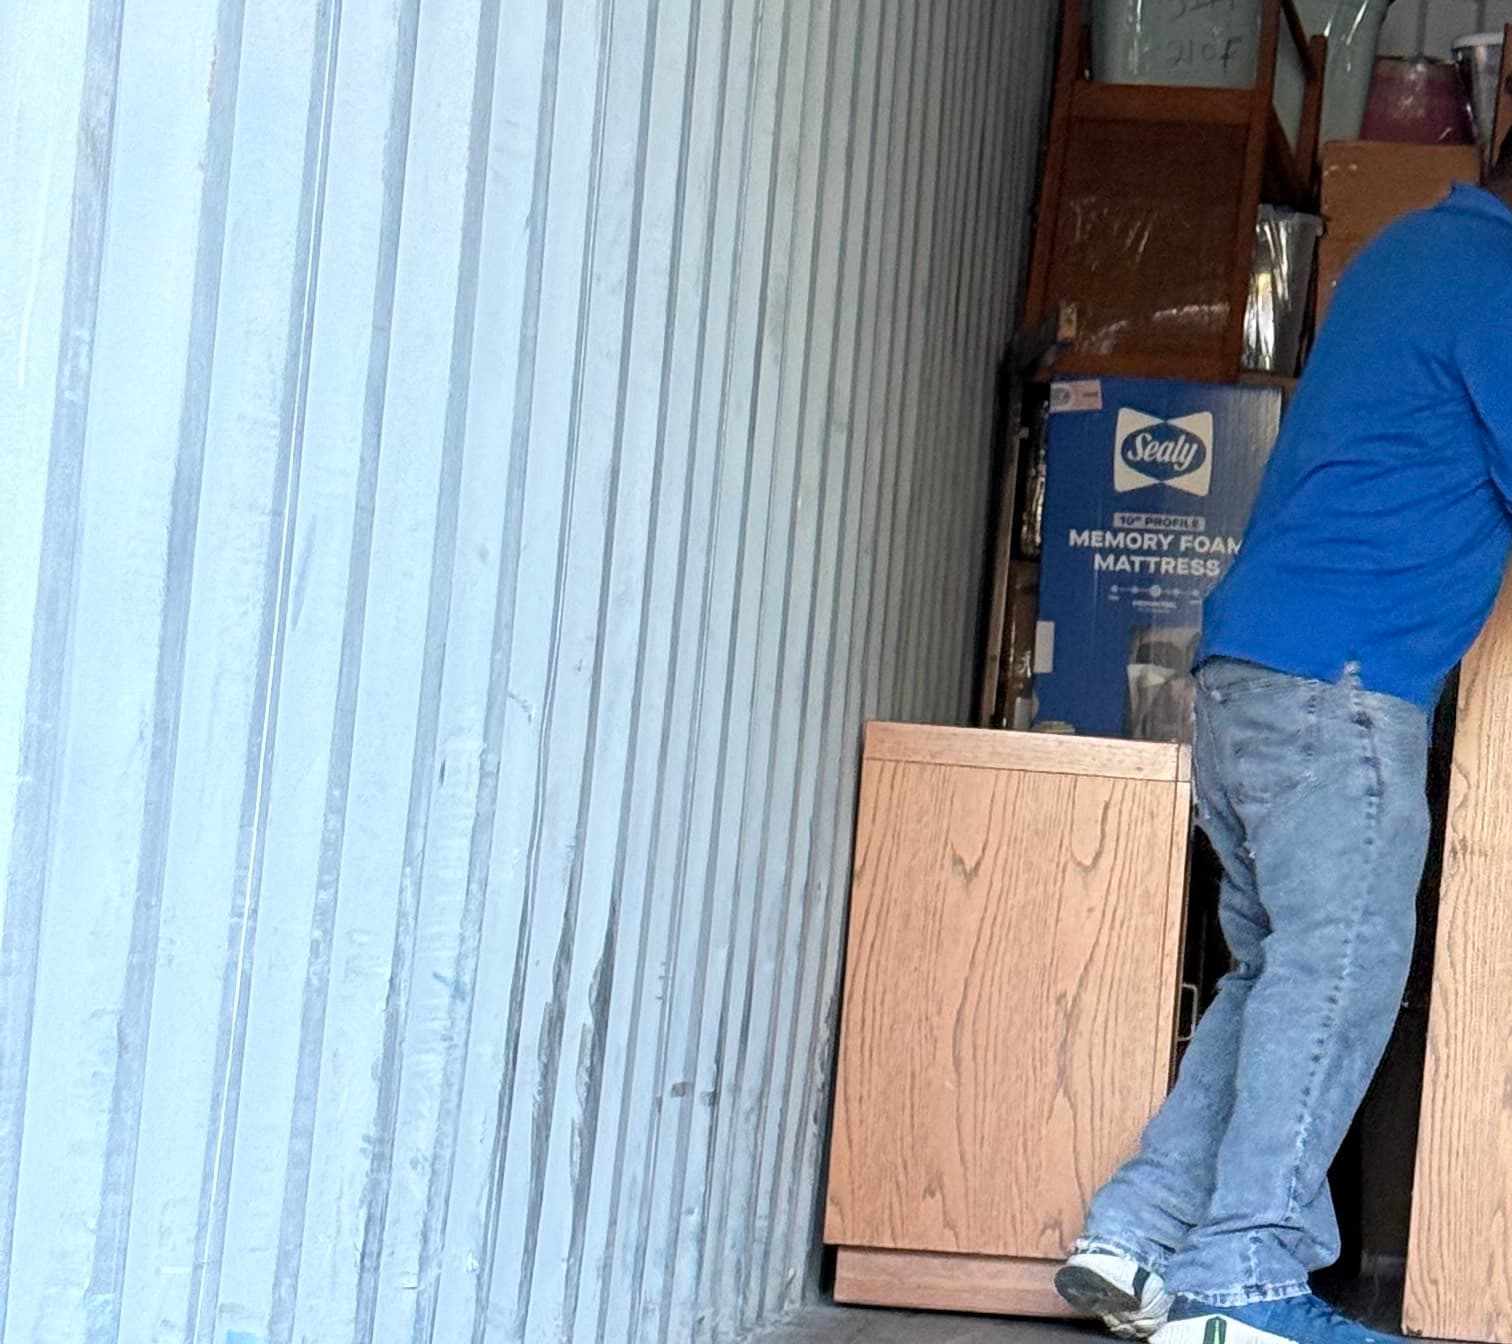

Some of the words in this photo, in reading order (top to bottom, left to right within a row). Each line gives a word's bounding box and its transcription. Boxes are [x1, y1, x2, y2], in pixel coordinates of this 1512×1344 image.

[1126, 432, 1199, 469] Sealy
[1145, 516, 1199, 529] PROFILE
[1069, 529, 1176, 552] MEMORY
[1180, 535, 1243, 555] FOAM
[1093, 554, 1221, 576] MATTRESS
